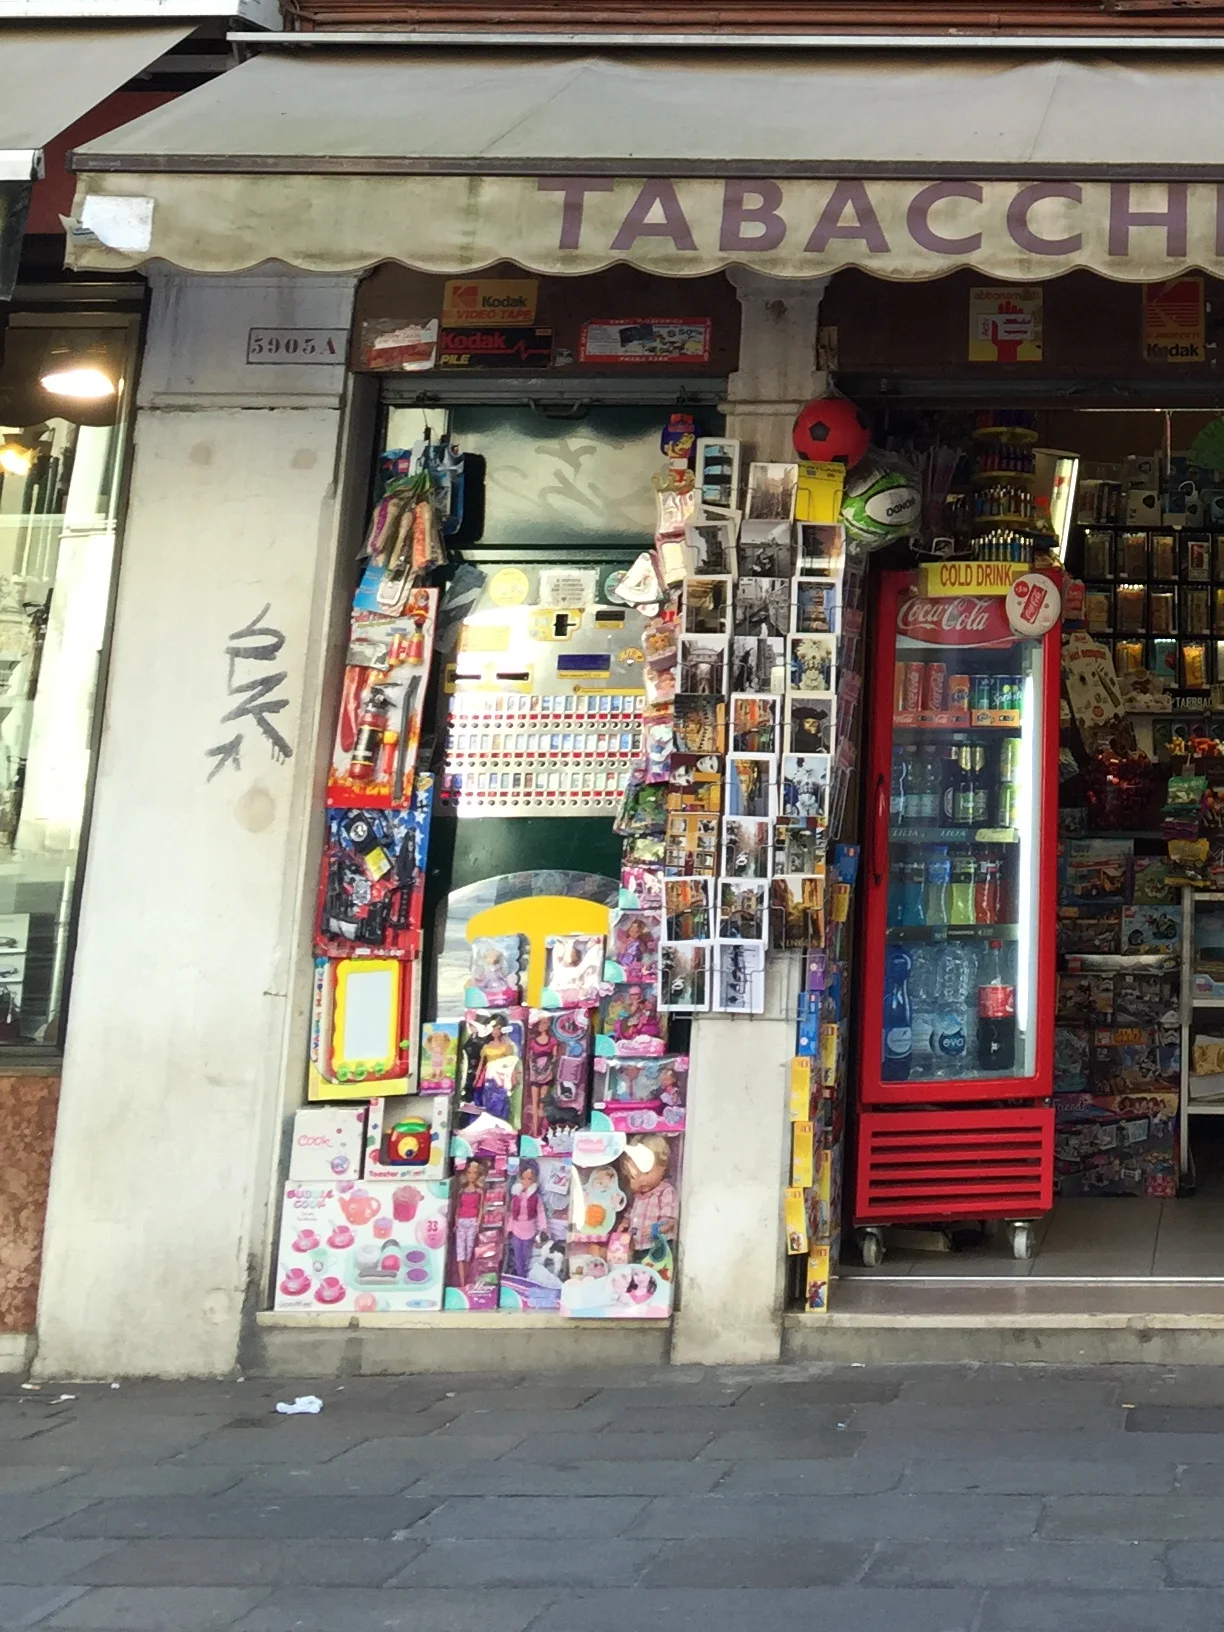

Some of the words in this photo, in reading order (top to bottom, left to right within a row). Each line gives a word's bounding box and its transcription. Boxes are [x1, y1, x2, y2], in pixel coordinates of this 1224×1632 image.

[482, 296, 527, 307] Kodak
[456, 310, 496, 319] VIDEO
[501, 310, 532, 319] TAPE
[441, 332, 507, 348] Kodak
[440, 354, 471, 365] PILE
[940, 563, 973, 587] COLD
[976, 563, 1012, 586] DRINK
[942, 1037, 964, 1048] eva
